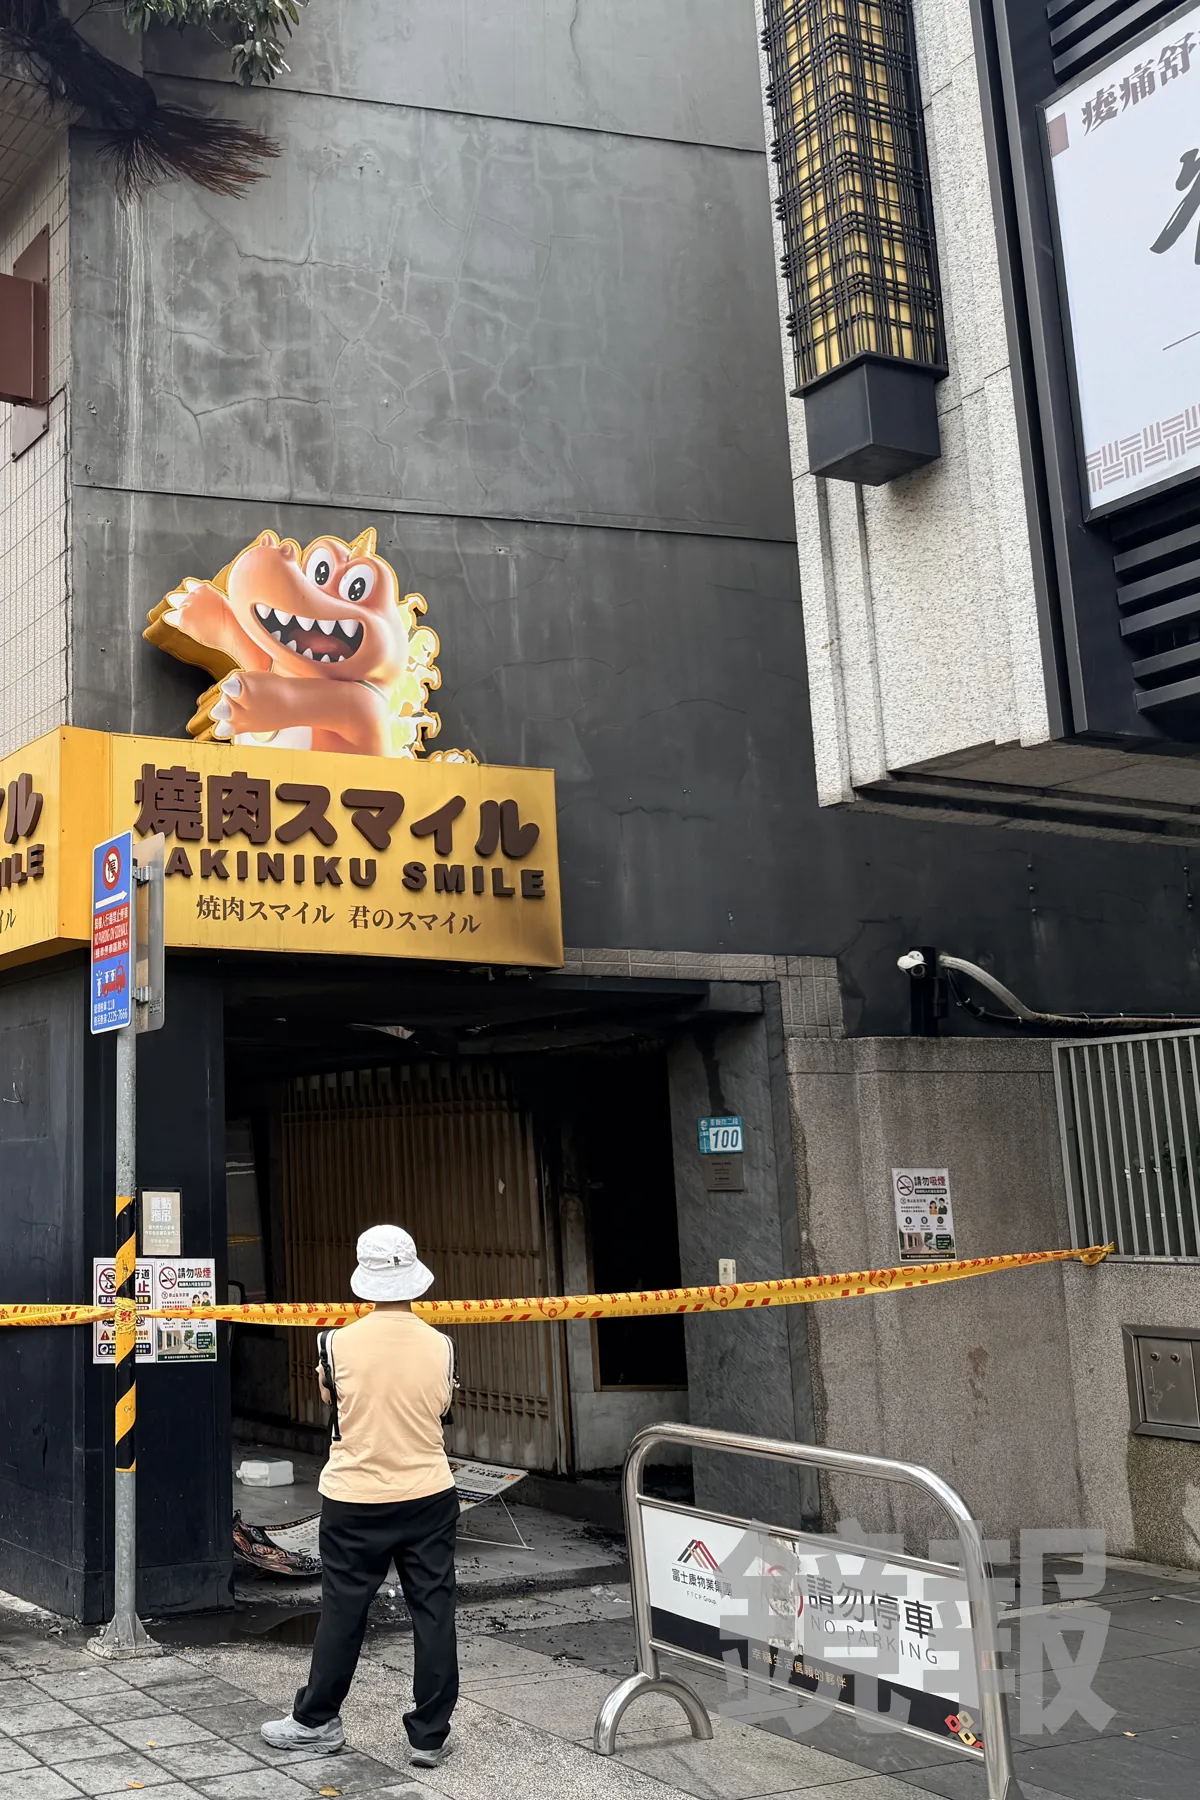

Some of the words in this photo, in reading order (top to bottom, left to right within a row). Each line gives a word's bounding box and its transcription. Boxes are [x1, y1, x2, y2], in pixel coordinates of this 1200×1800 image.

[1081, 31, 1200, 136] 痠痛舒
[134, 764, 540, 858] 燒肉スマイル
[164, 846, 376, 887] AKINIKU
[402, 861, 546, 898] SMILE
[196, 896, 335, 925] 焼肉スマイル
[349, 905, 482, 935] 君のスマイル
[712, 1129, 739, 1148] 100
[177, 1267, 212, 1279] 請勿吸煙
[806, 1573, 936, 1639] 請勿停車
[810, 1614, 836, 1635] NO
[846, 1624, 938, 1665] PARKING
